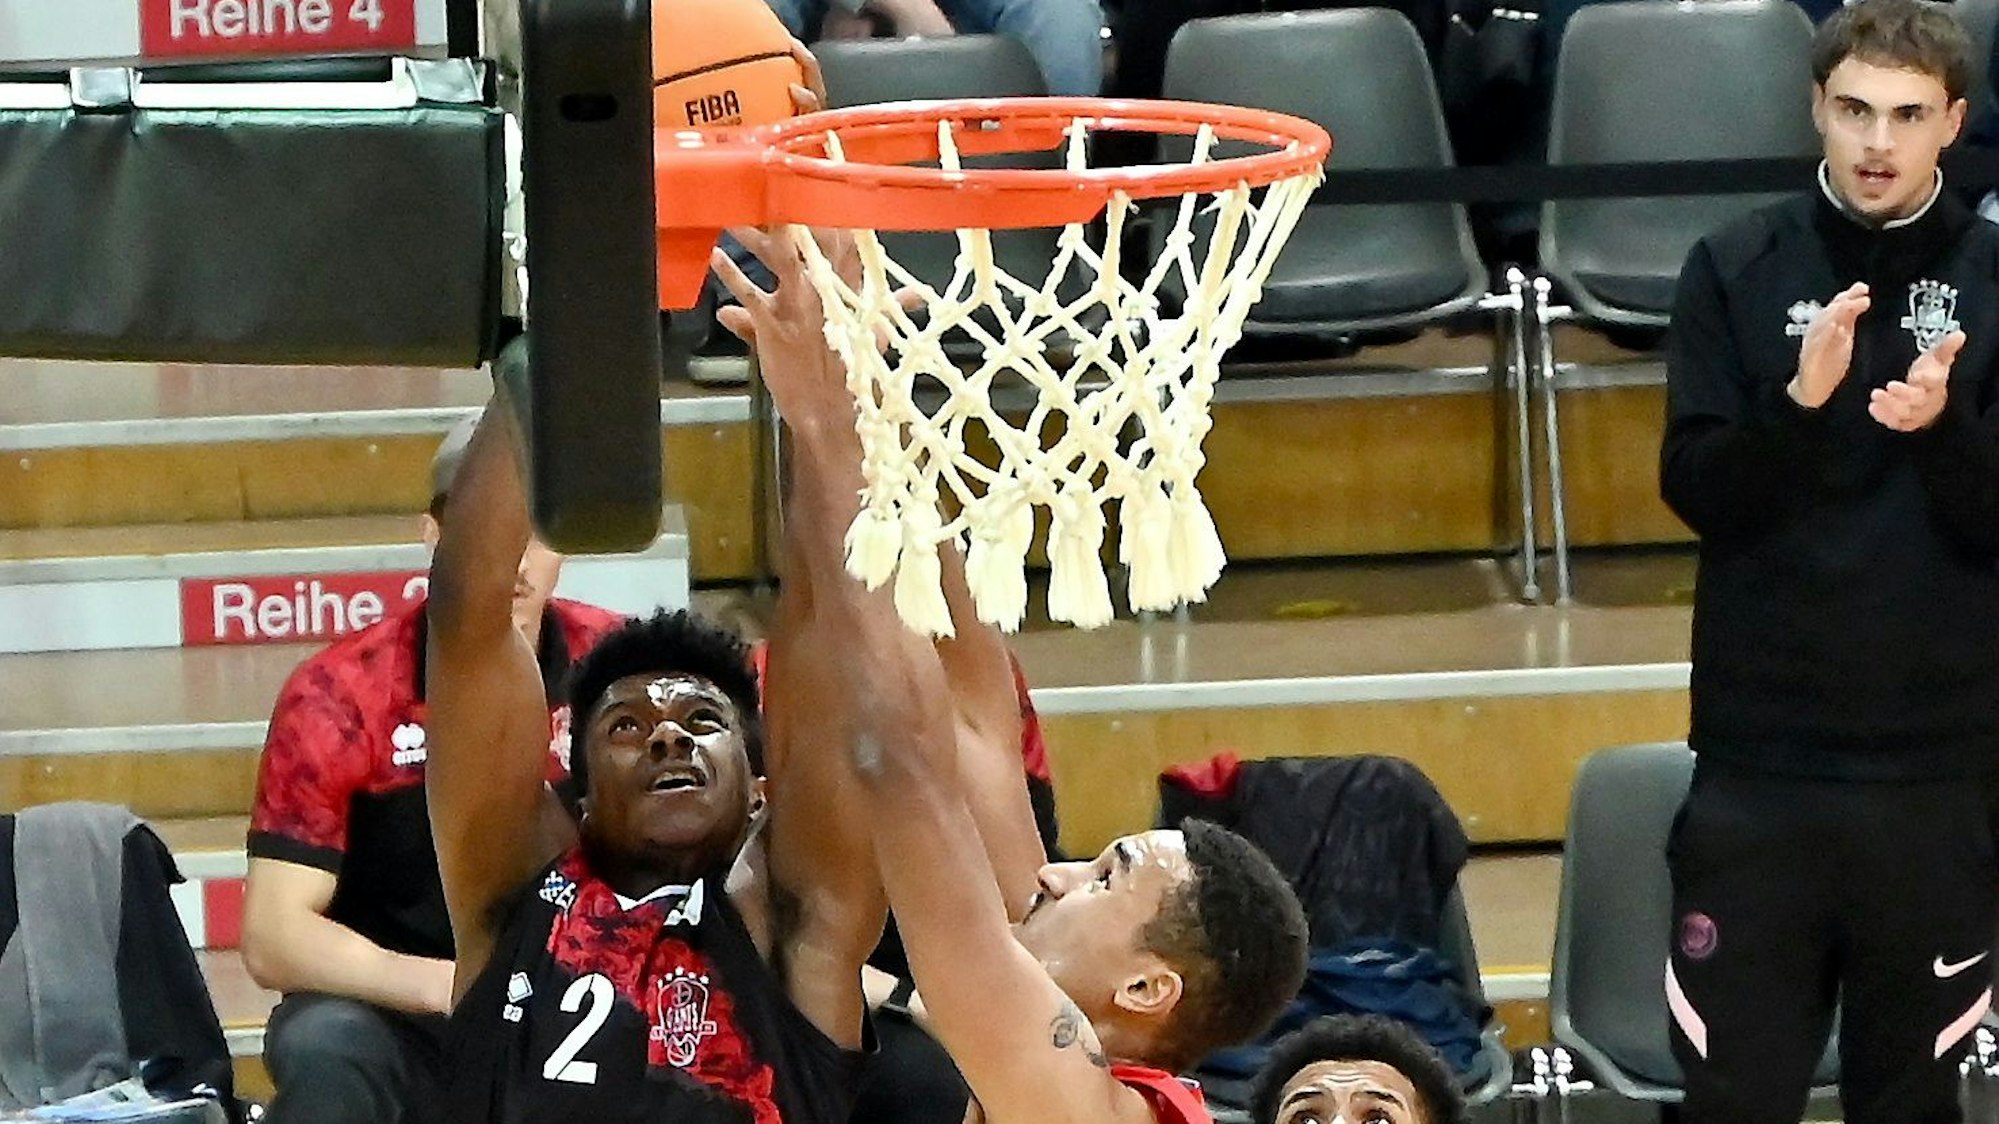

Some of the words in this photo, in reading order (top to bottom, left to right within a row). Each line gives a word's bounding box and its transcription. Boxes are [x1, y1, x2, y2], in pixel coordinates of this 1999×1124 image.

[169, 0, 333, 38] Reihe
[348, 0, 385, 32] 4
[685, 90, 740, 126] FIBA
[212, 580, 384, 638] Reihe
[542, 972, 616, 1085] 2
